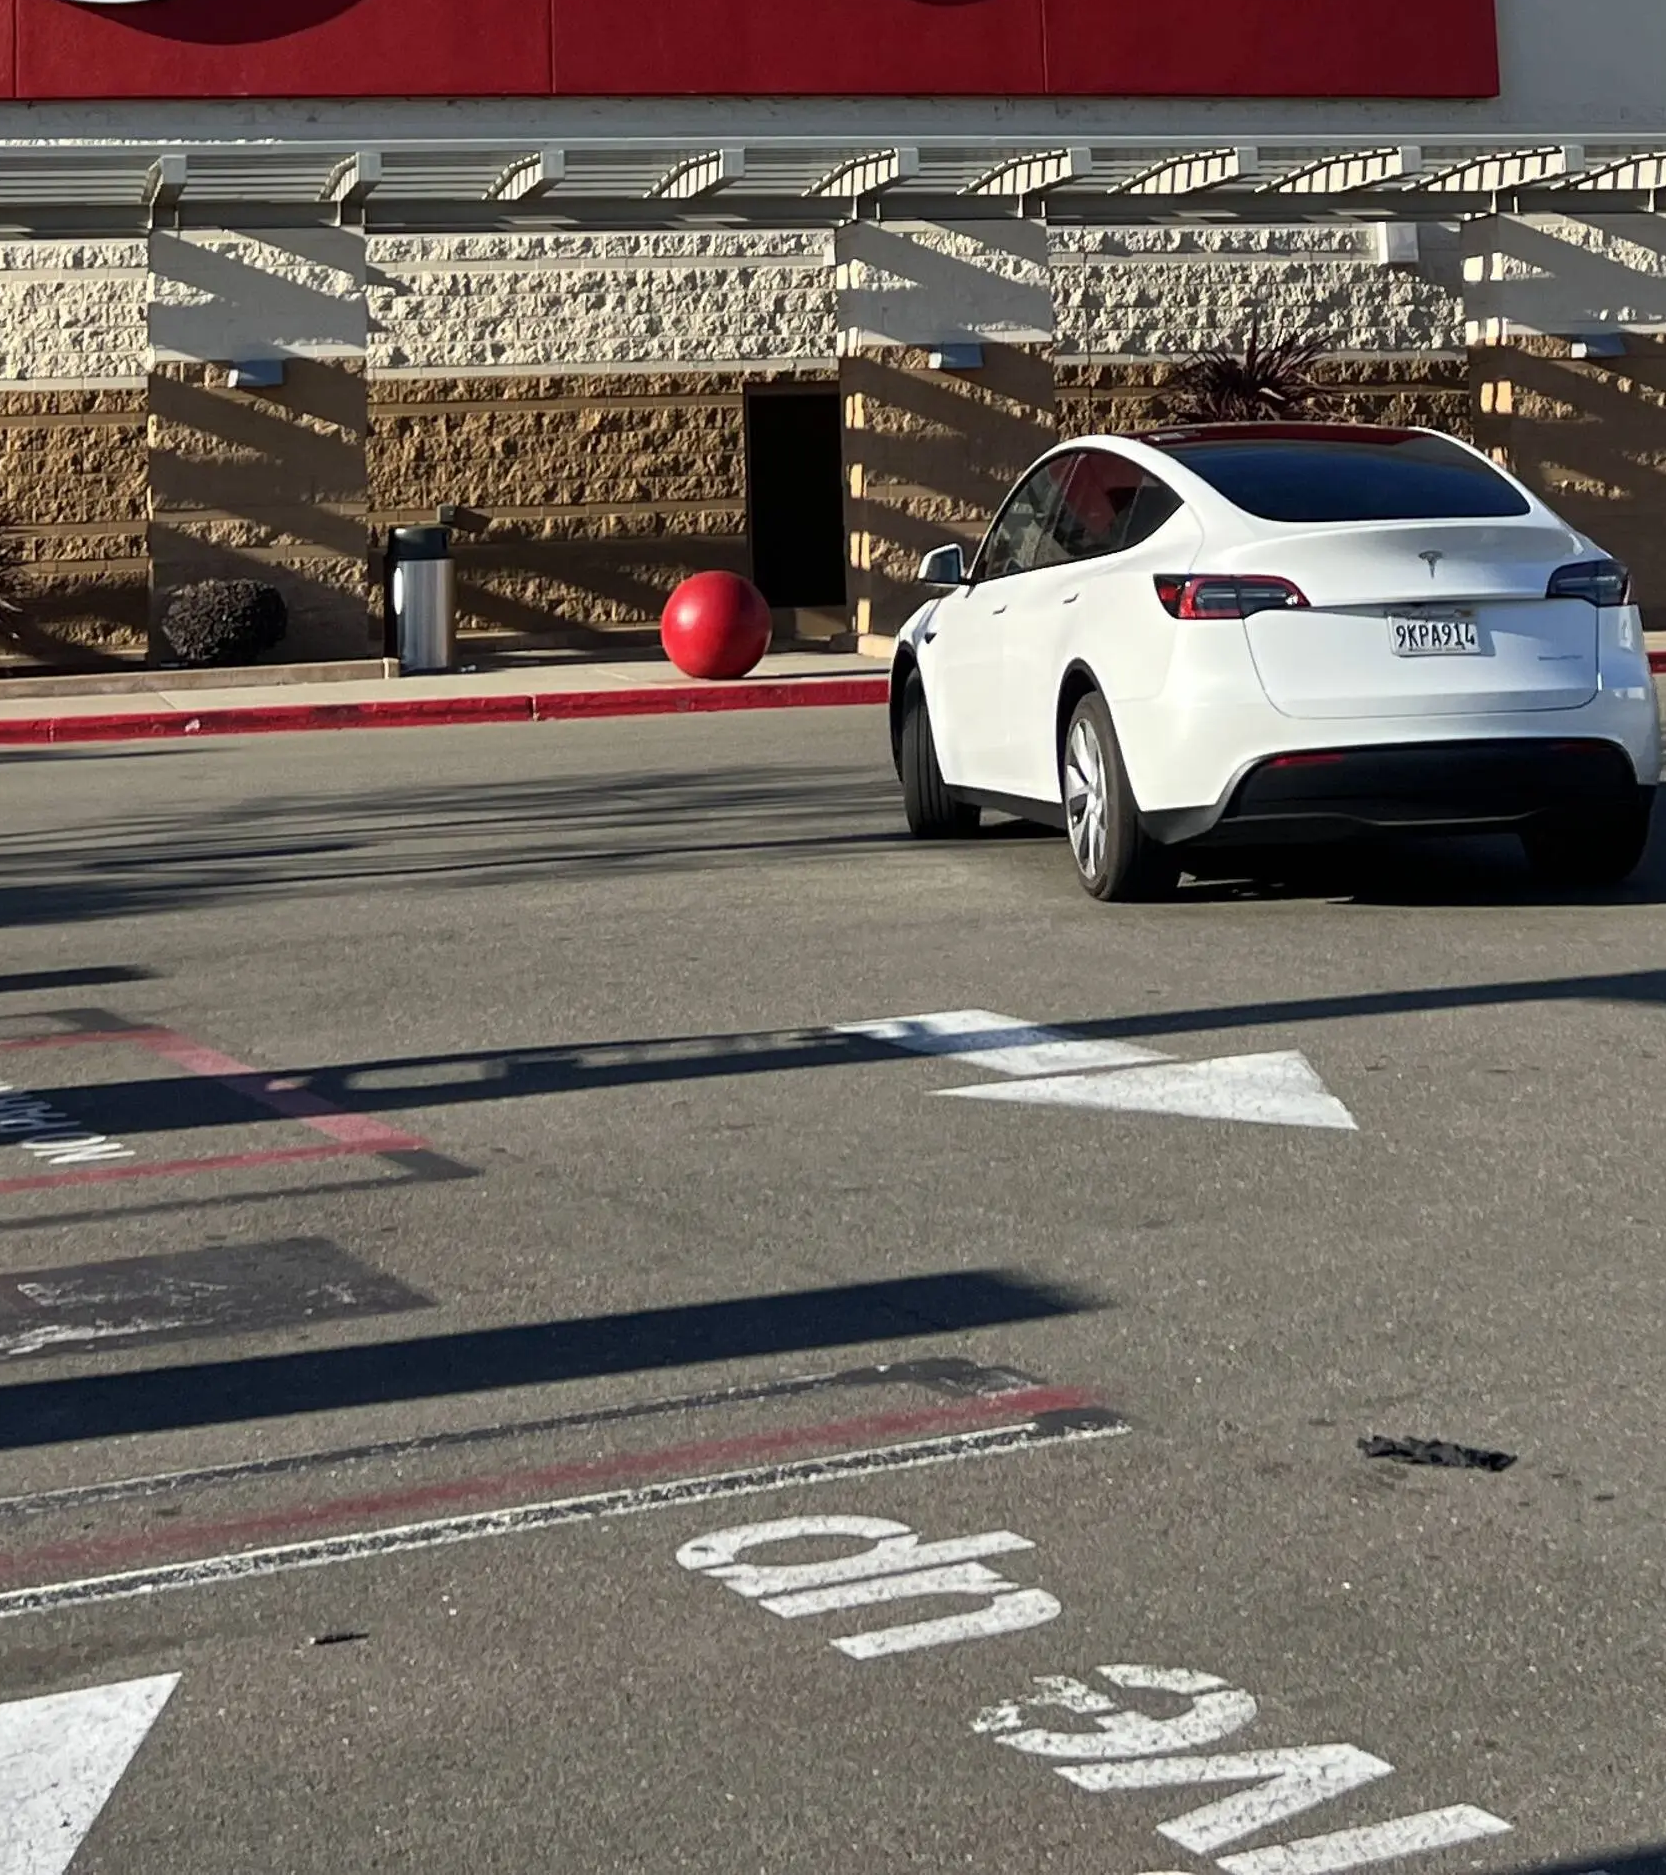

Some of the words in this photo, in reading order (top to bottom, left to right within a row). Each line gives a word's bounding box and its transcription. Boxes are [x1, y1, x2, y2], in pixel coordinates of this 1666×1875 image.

[1395, 622, 1475, 648] 9KPA914
[20, 1131, 136, 1165] NO
[674, 1513, 1062, 1661] up
